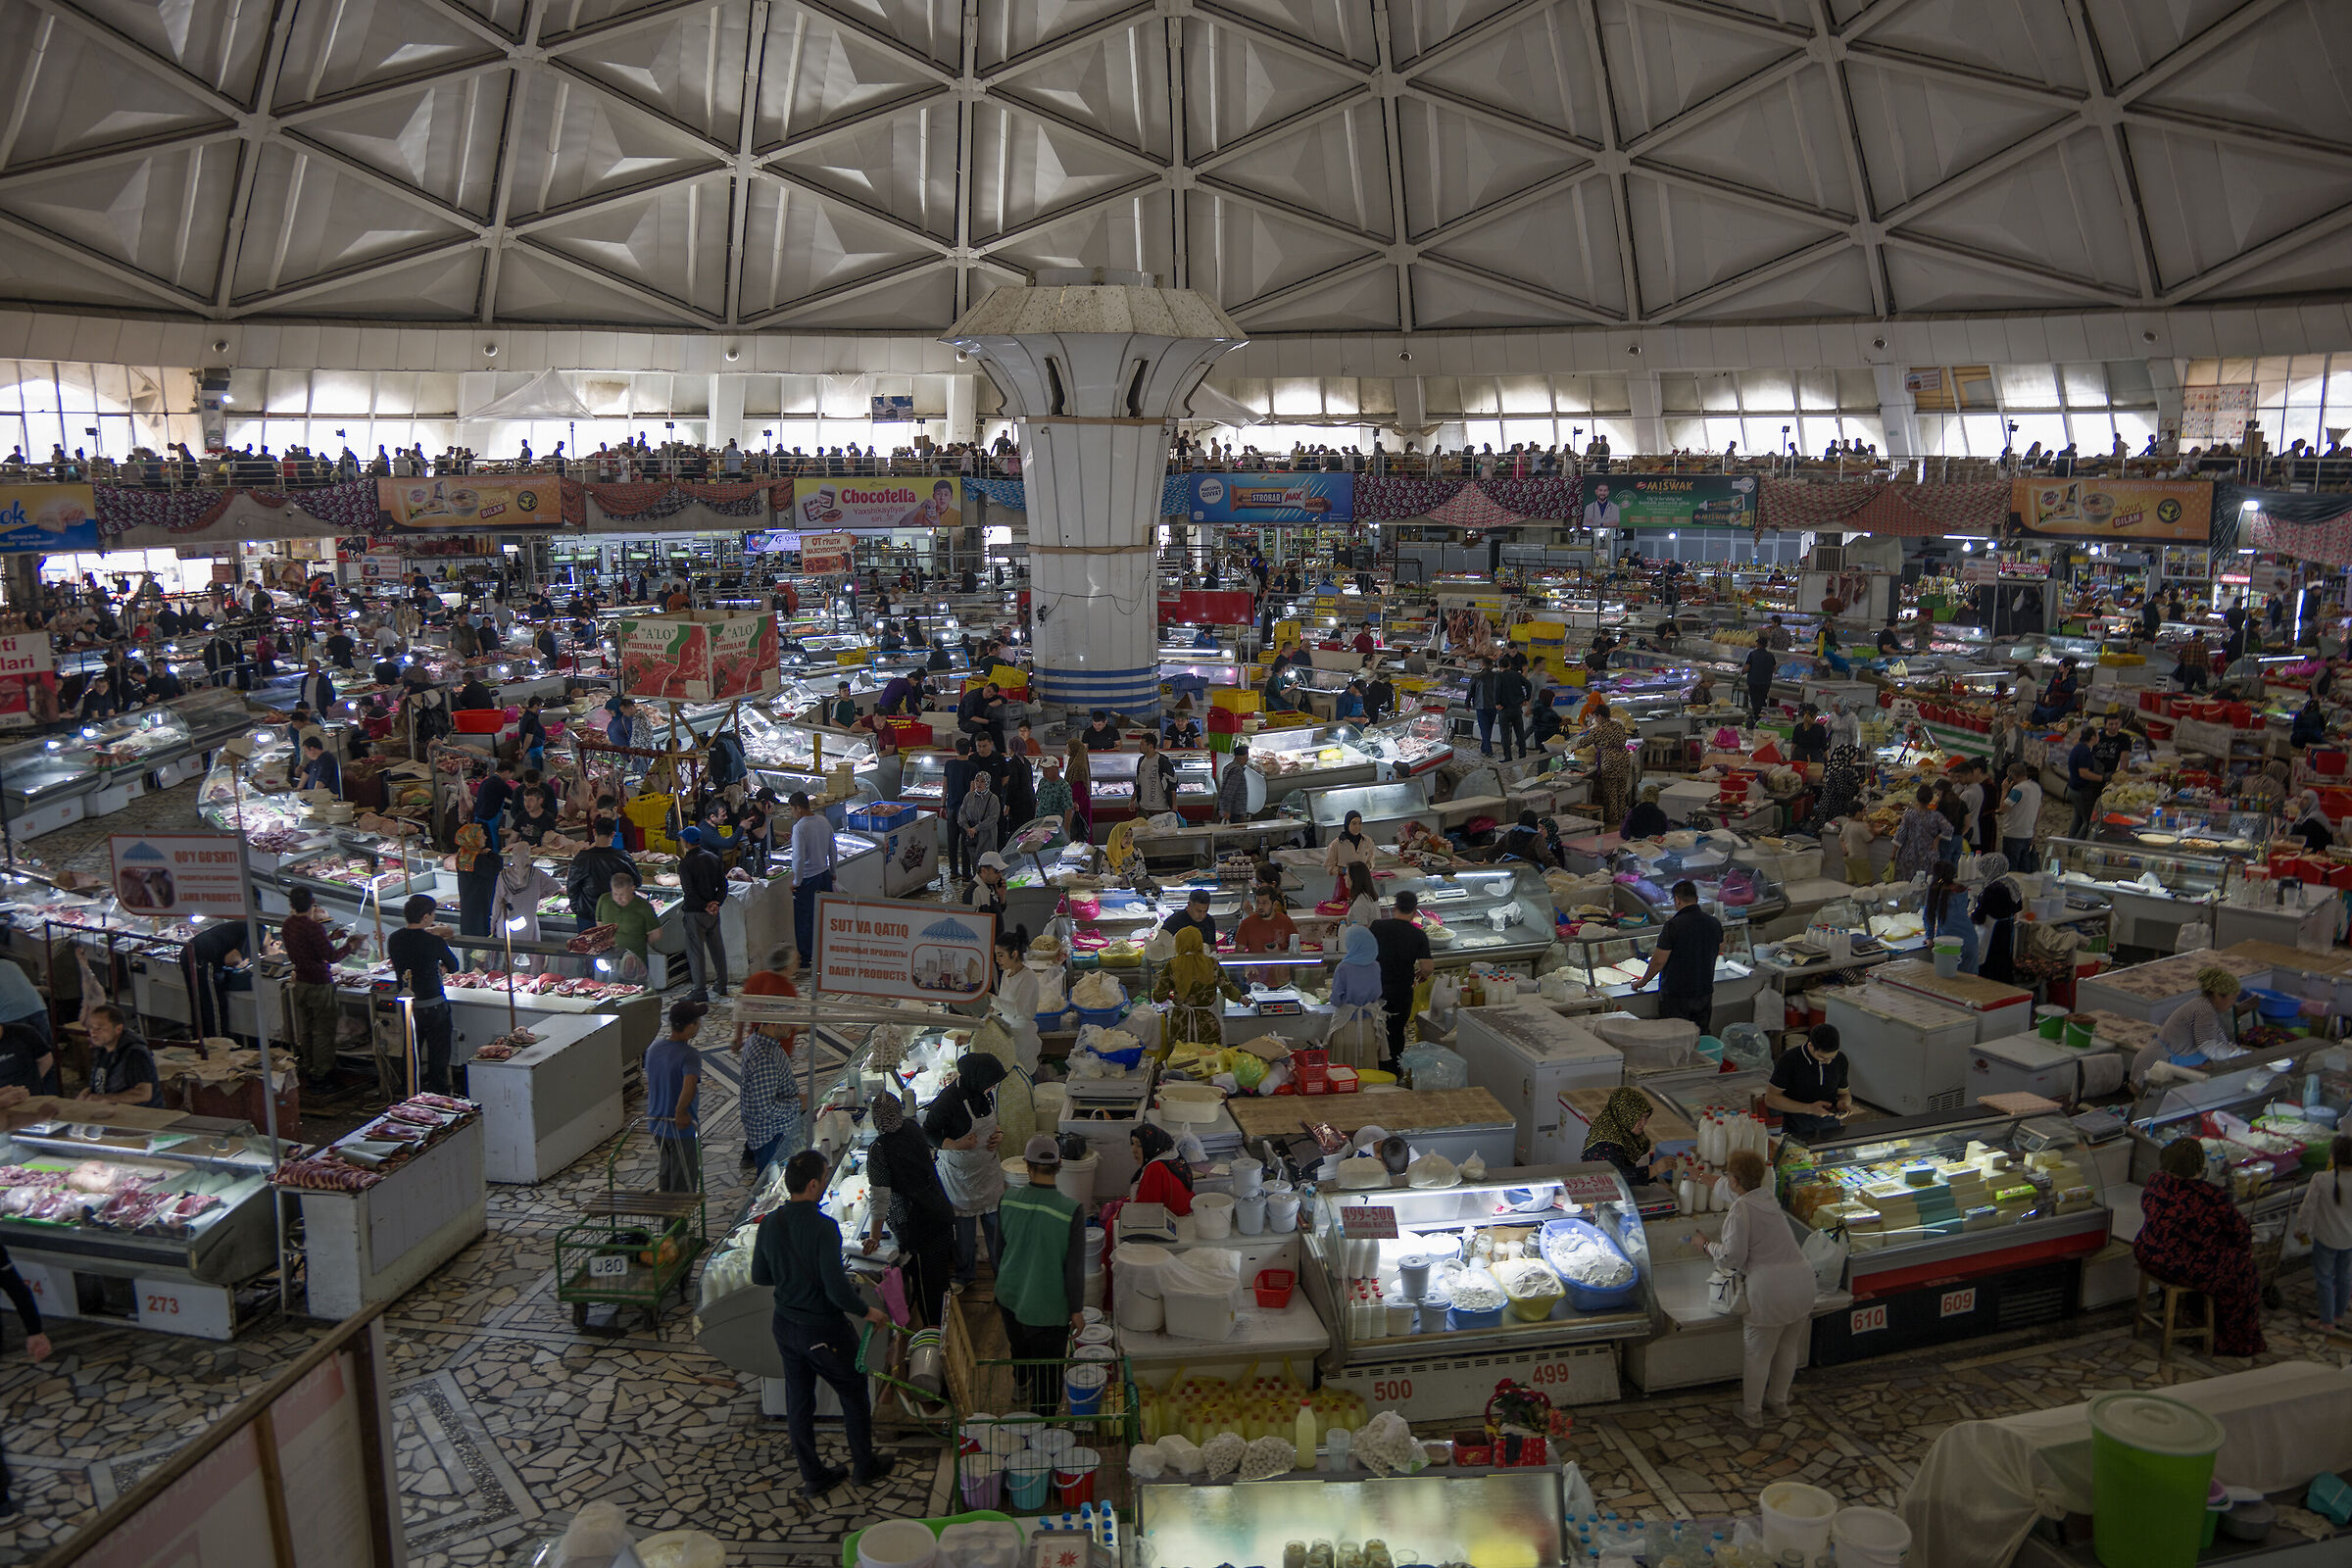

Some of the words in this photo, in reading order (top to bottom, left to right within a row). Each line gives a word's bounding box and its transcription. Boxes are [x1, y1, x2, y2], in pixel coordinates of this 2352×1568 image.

[1646, 481, 1693, 492] MISWAK
[841, 488, 916, 504] Chocotella
[1251, 493, 1282, 503] STROBAR
[1284, 491, 1303, 502] MAX
[2115, 513, 2141, 527] BILAN
[0, 637, 16, 651] ti
[174, 851, 196, 863] QO'Y
[199, 851, 238, 863] GO'SHTI
[179, 893, 201, 902] LAMB
[201, 893, 242, 903] PRODUCTS
[830, 918, 853, 932] SUT
[857, 920, 871, 934] VA
[874, 923, 908, 939] QATIQ
[829, 945, 869, 956] МОЛОЧНЫЕ
[870, 948, 908, 958] ПРОДУКТЫ
[828, 965, 856, 978] DAIRY
[858, 967, 906, 982] PRODUCTS
[1564, 1175, 1614, 1188] 499-500
[1343, 1206, 1395, 1220] 499-500
[595, 1257, 623, 1273] J80
[147, 1295, 179, 1313] 273
[1942, 1293, 1973, 1312] 609
[1853, 1309, 1884, 1330] 610
[1532, 1363, 1568, 1385] 499
[1374, 1379, 1412, 1401] 500
